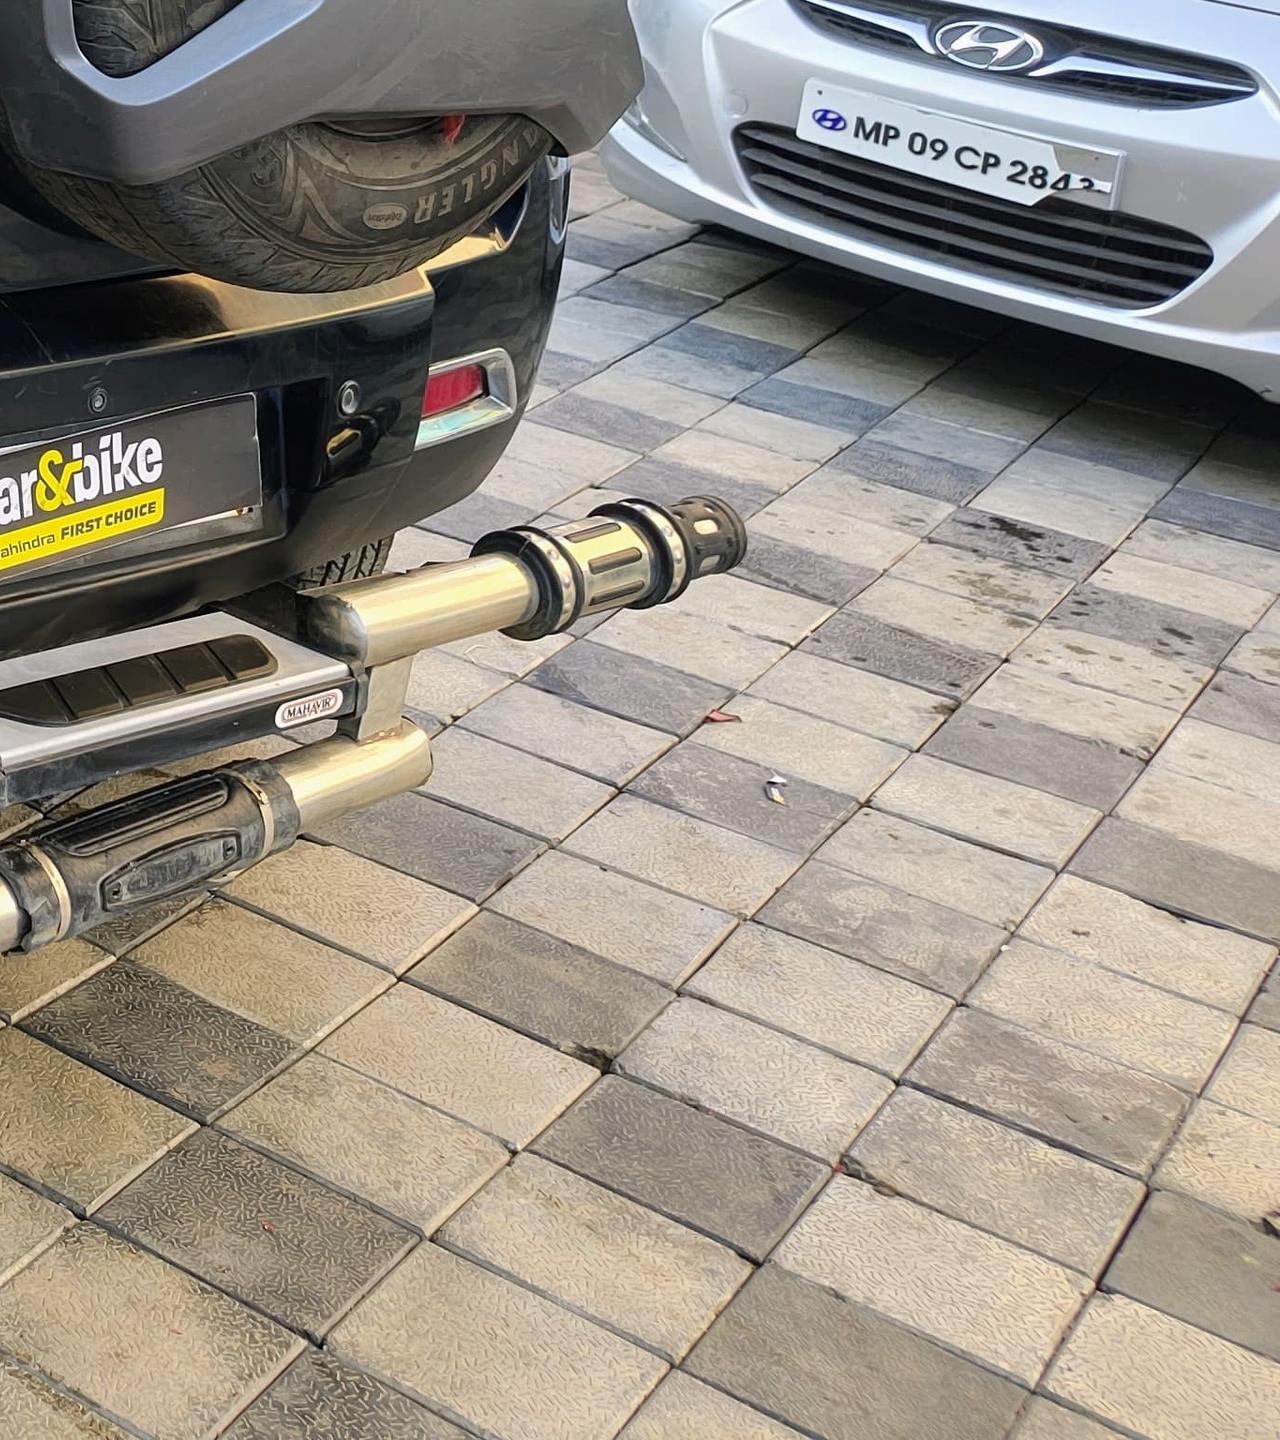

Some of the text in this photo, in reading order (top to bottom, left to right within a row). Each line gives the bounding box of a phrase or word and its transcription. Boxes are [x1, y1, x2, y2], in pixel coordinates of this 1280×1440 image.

[853, 116, 900, 148] MP
[907, 132, 949, 161] 09
[954, 146, 1001, 175] CP
[414, 127, 540, 224] ANGLER
[60, 516, 103, 541] FIRST
[104, 500, 157, 527] CHOICE
[287, 697, 332, 718] MAHAVIR
